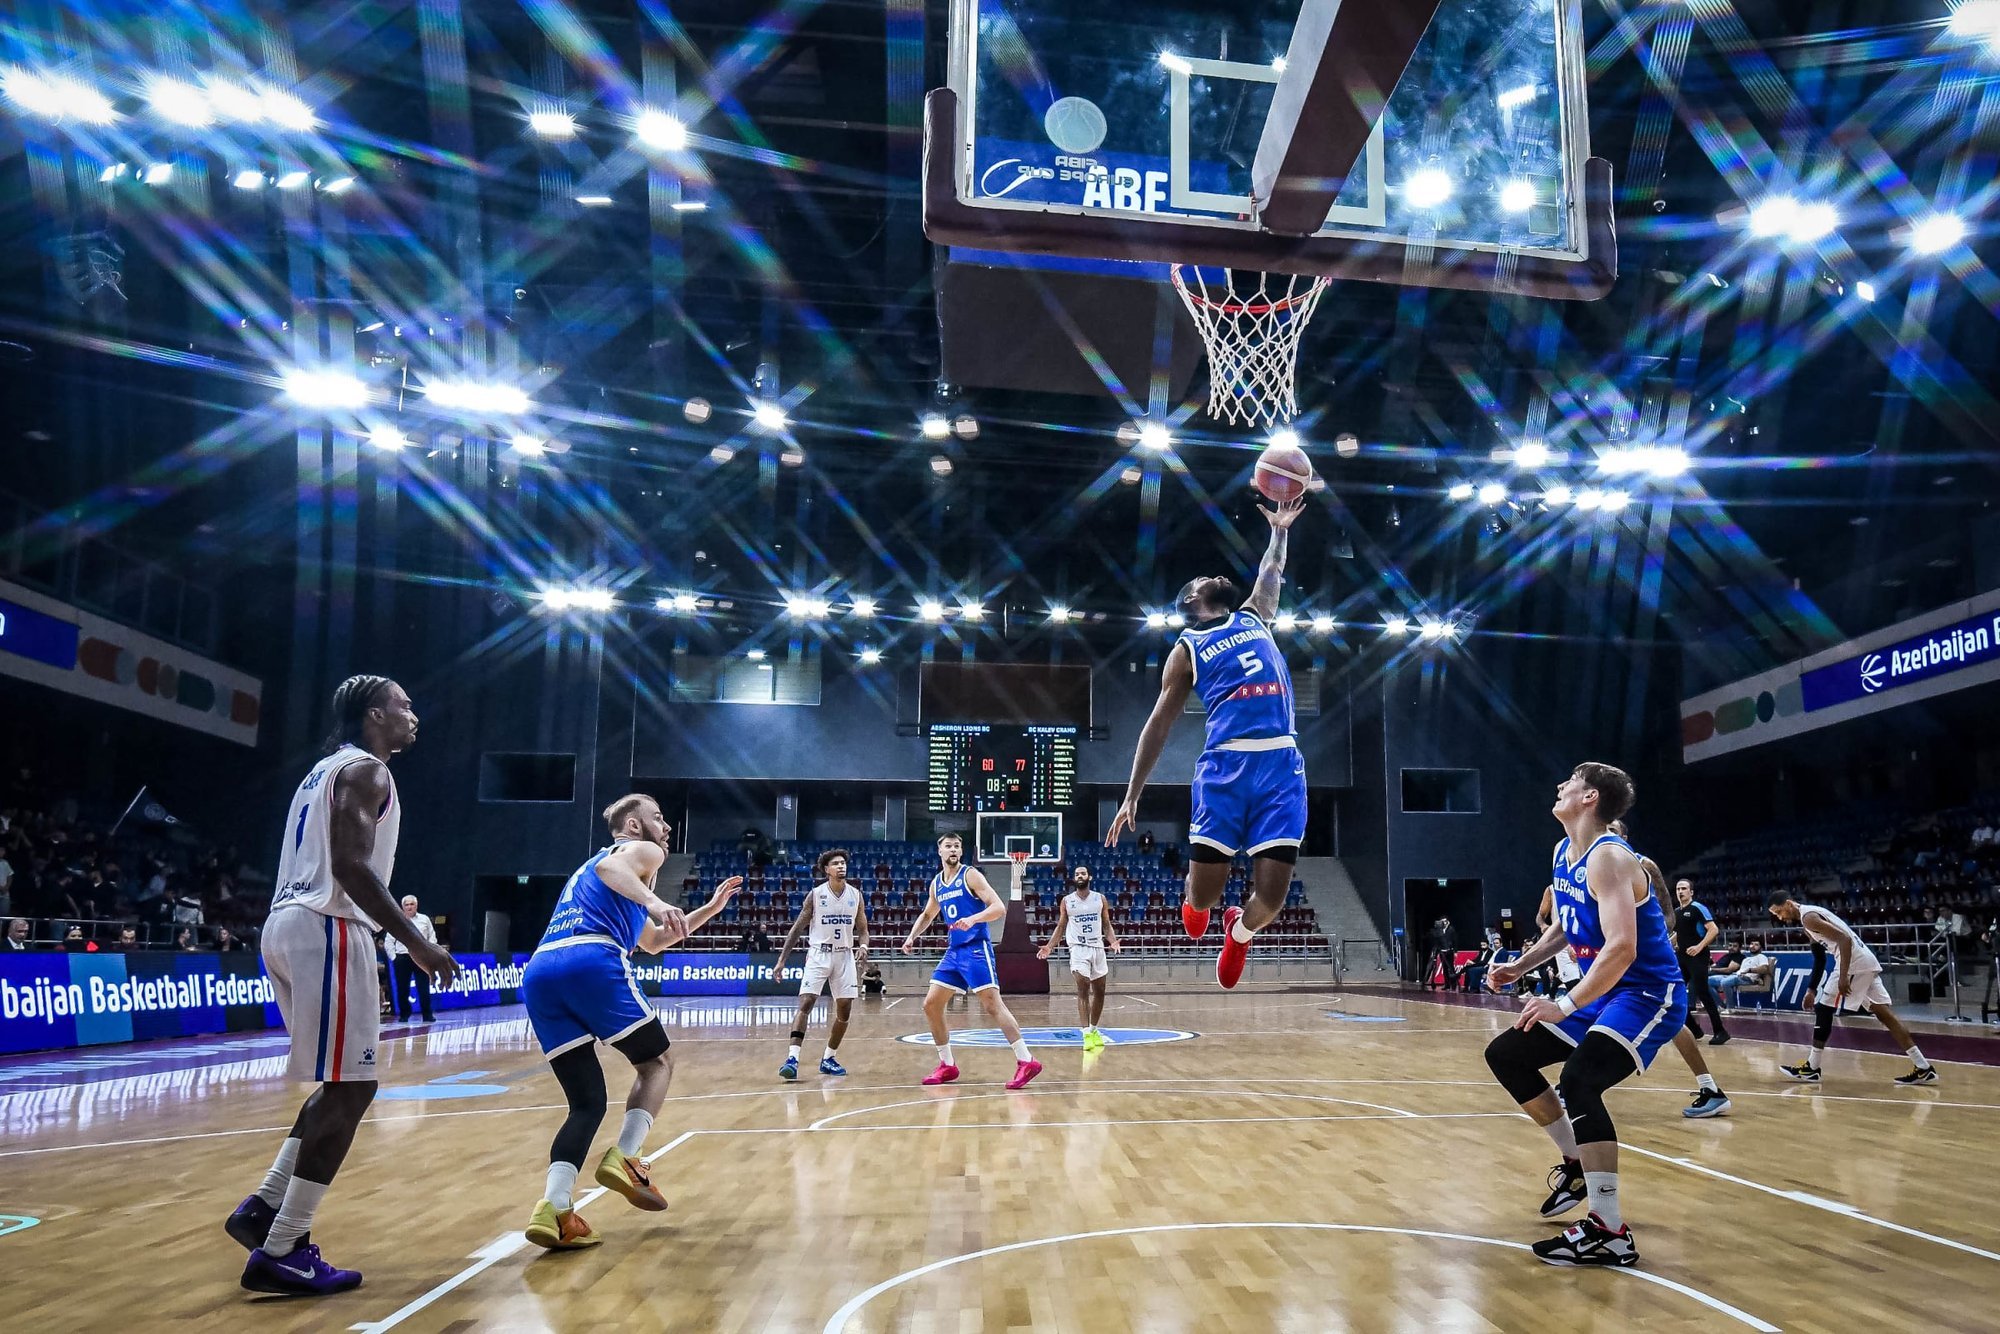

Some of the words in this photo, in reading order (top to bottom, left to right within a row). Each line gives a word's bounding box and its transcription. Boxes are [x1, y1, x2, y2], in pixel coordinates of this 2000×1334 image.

[1891, 627, 1989, 677] Azerbaijan
[1237, 650, 1264, 677] 5
[982, 758, 994, 771] 60
[1015, 759, 1026, 771] 77
[296, 803, 310, 856] 1
[834, 929, 841, 939] 5
[1082, 924, 1093, 933] 25
[683, 965, 754, 980] Basketball
[89, 973, 202, 1014] Basketball
